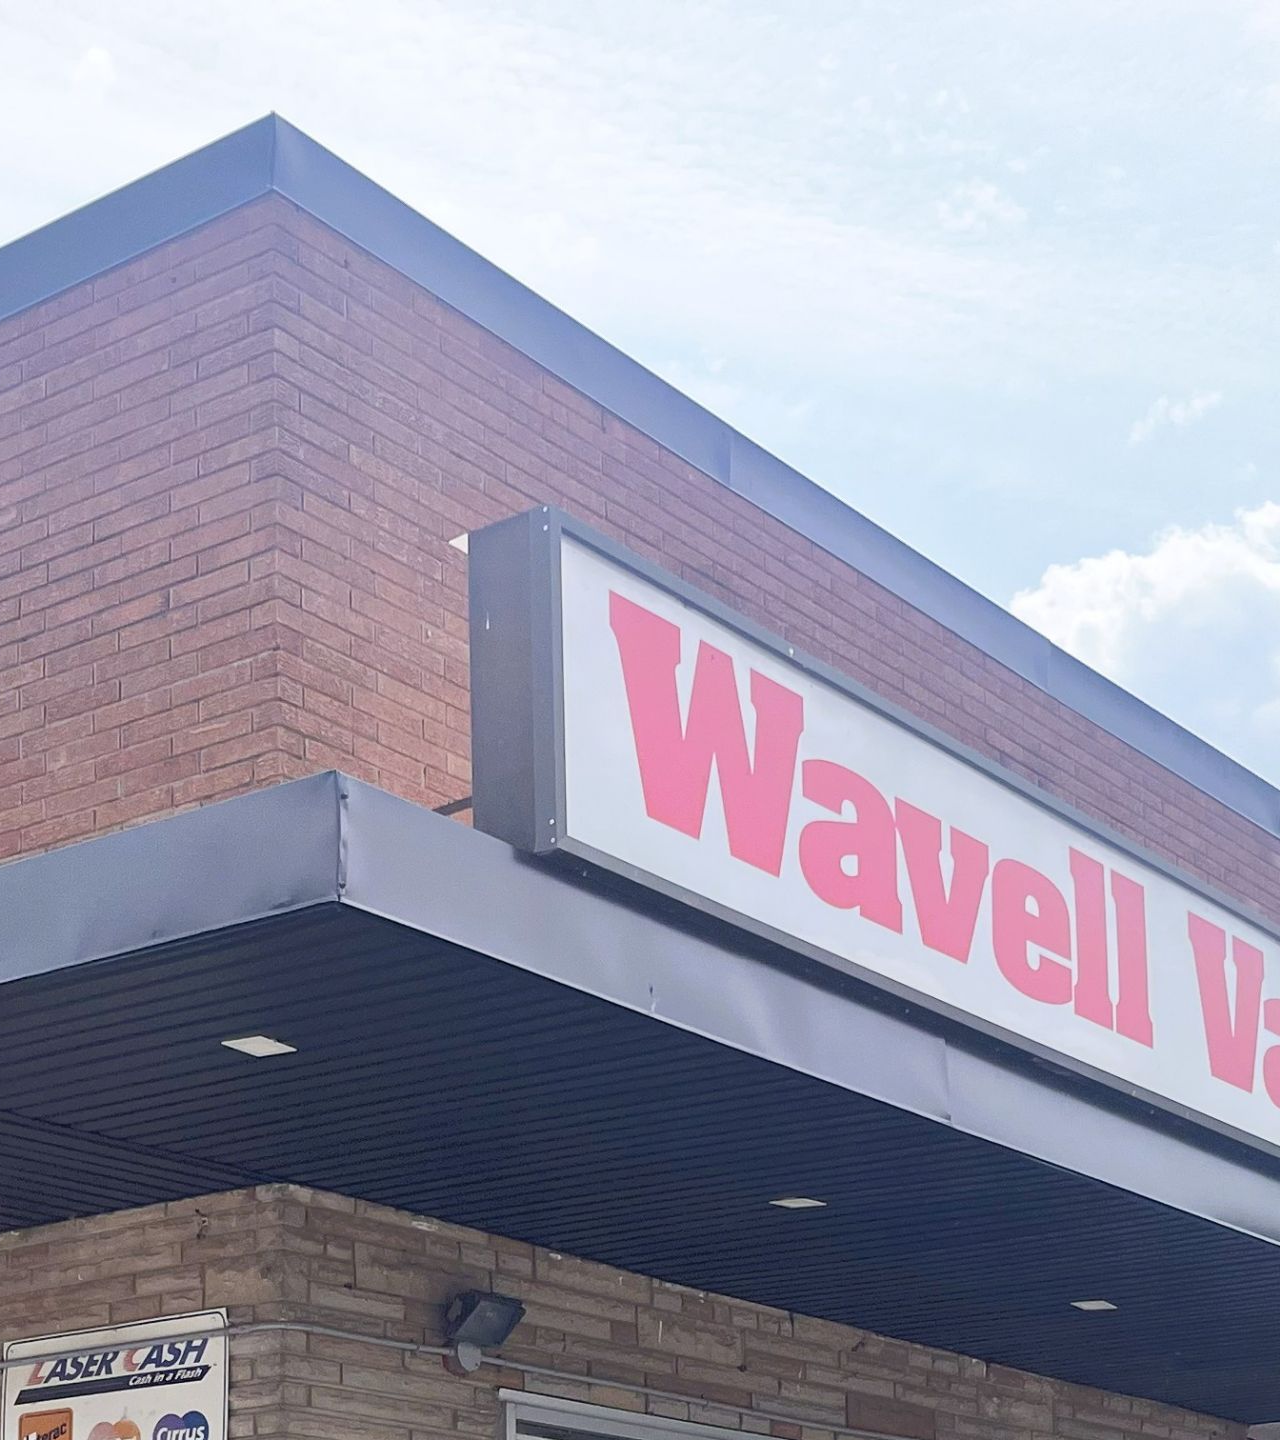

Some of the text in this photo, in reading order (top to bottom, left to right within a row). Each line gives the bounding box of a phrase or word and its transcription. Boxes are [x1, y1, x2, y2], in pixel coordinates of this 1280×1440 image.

[609, 589, 1154, 1049] Wavell
[26, 1337, 210, 1386] LASER CASH
[129, 1367, 202, 1386] Cash in a Flash
